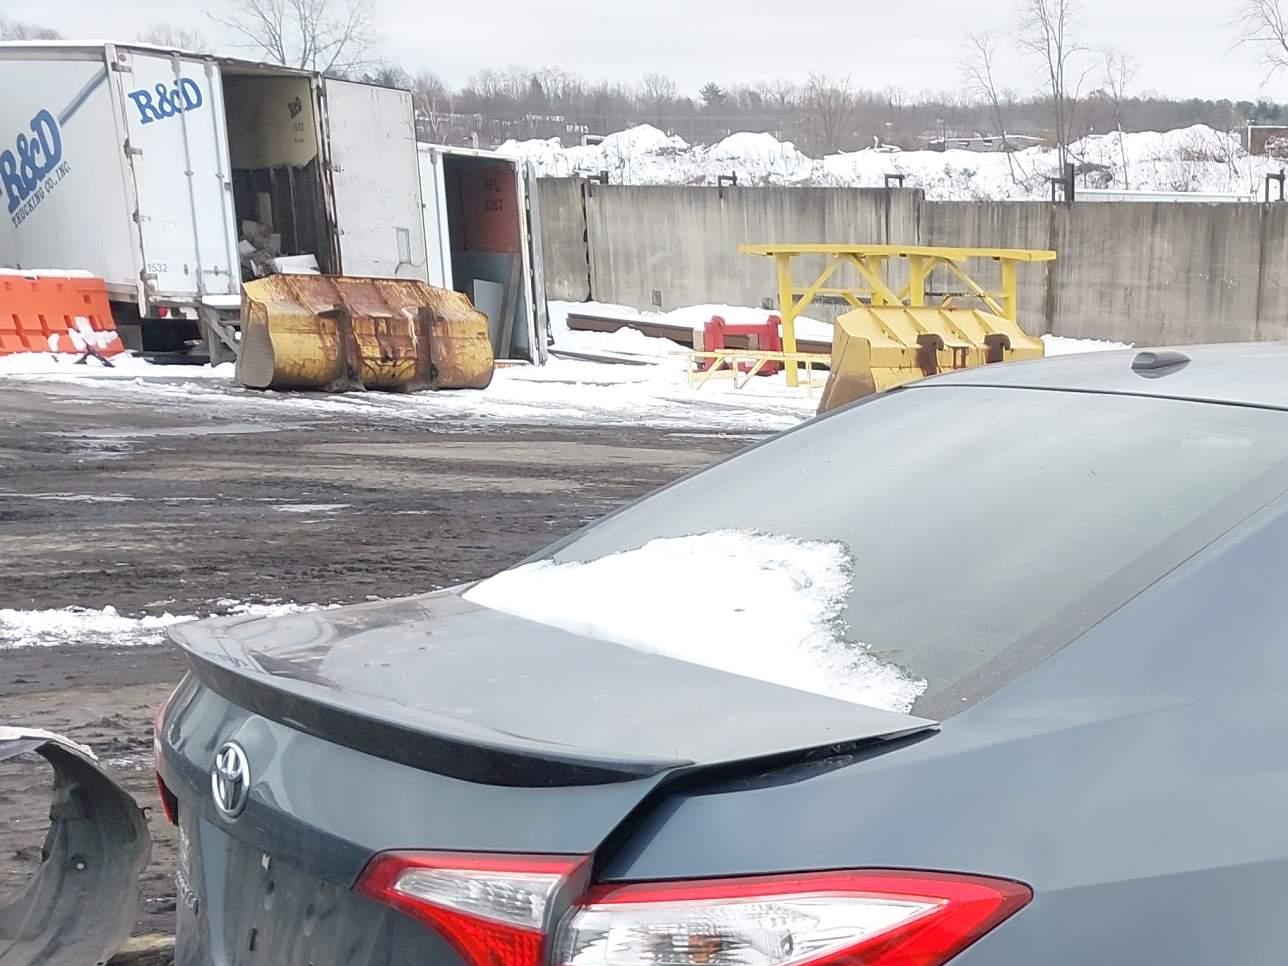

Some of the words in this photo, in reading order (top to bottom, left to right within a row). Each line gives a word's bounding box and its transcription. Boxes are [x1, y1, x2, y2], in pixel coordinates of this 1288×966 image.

[127, 77, 203, 124] R&D
[0, 109, 62, 214] R&D
[11, 186, 45, 229] TRUCKING
[147, 263, 168, 273] 1532
